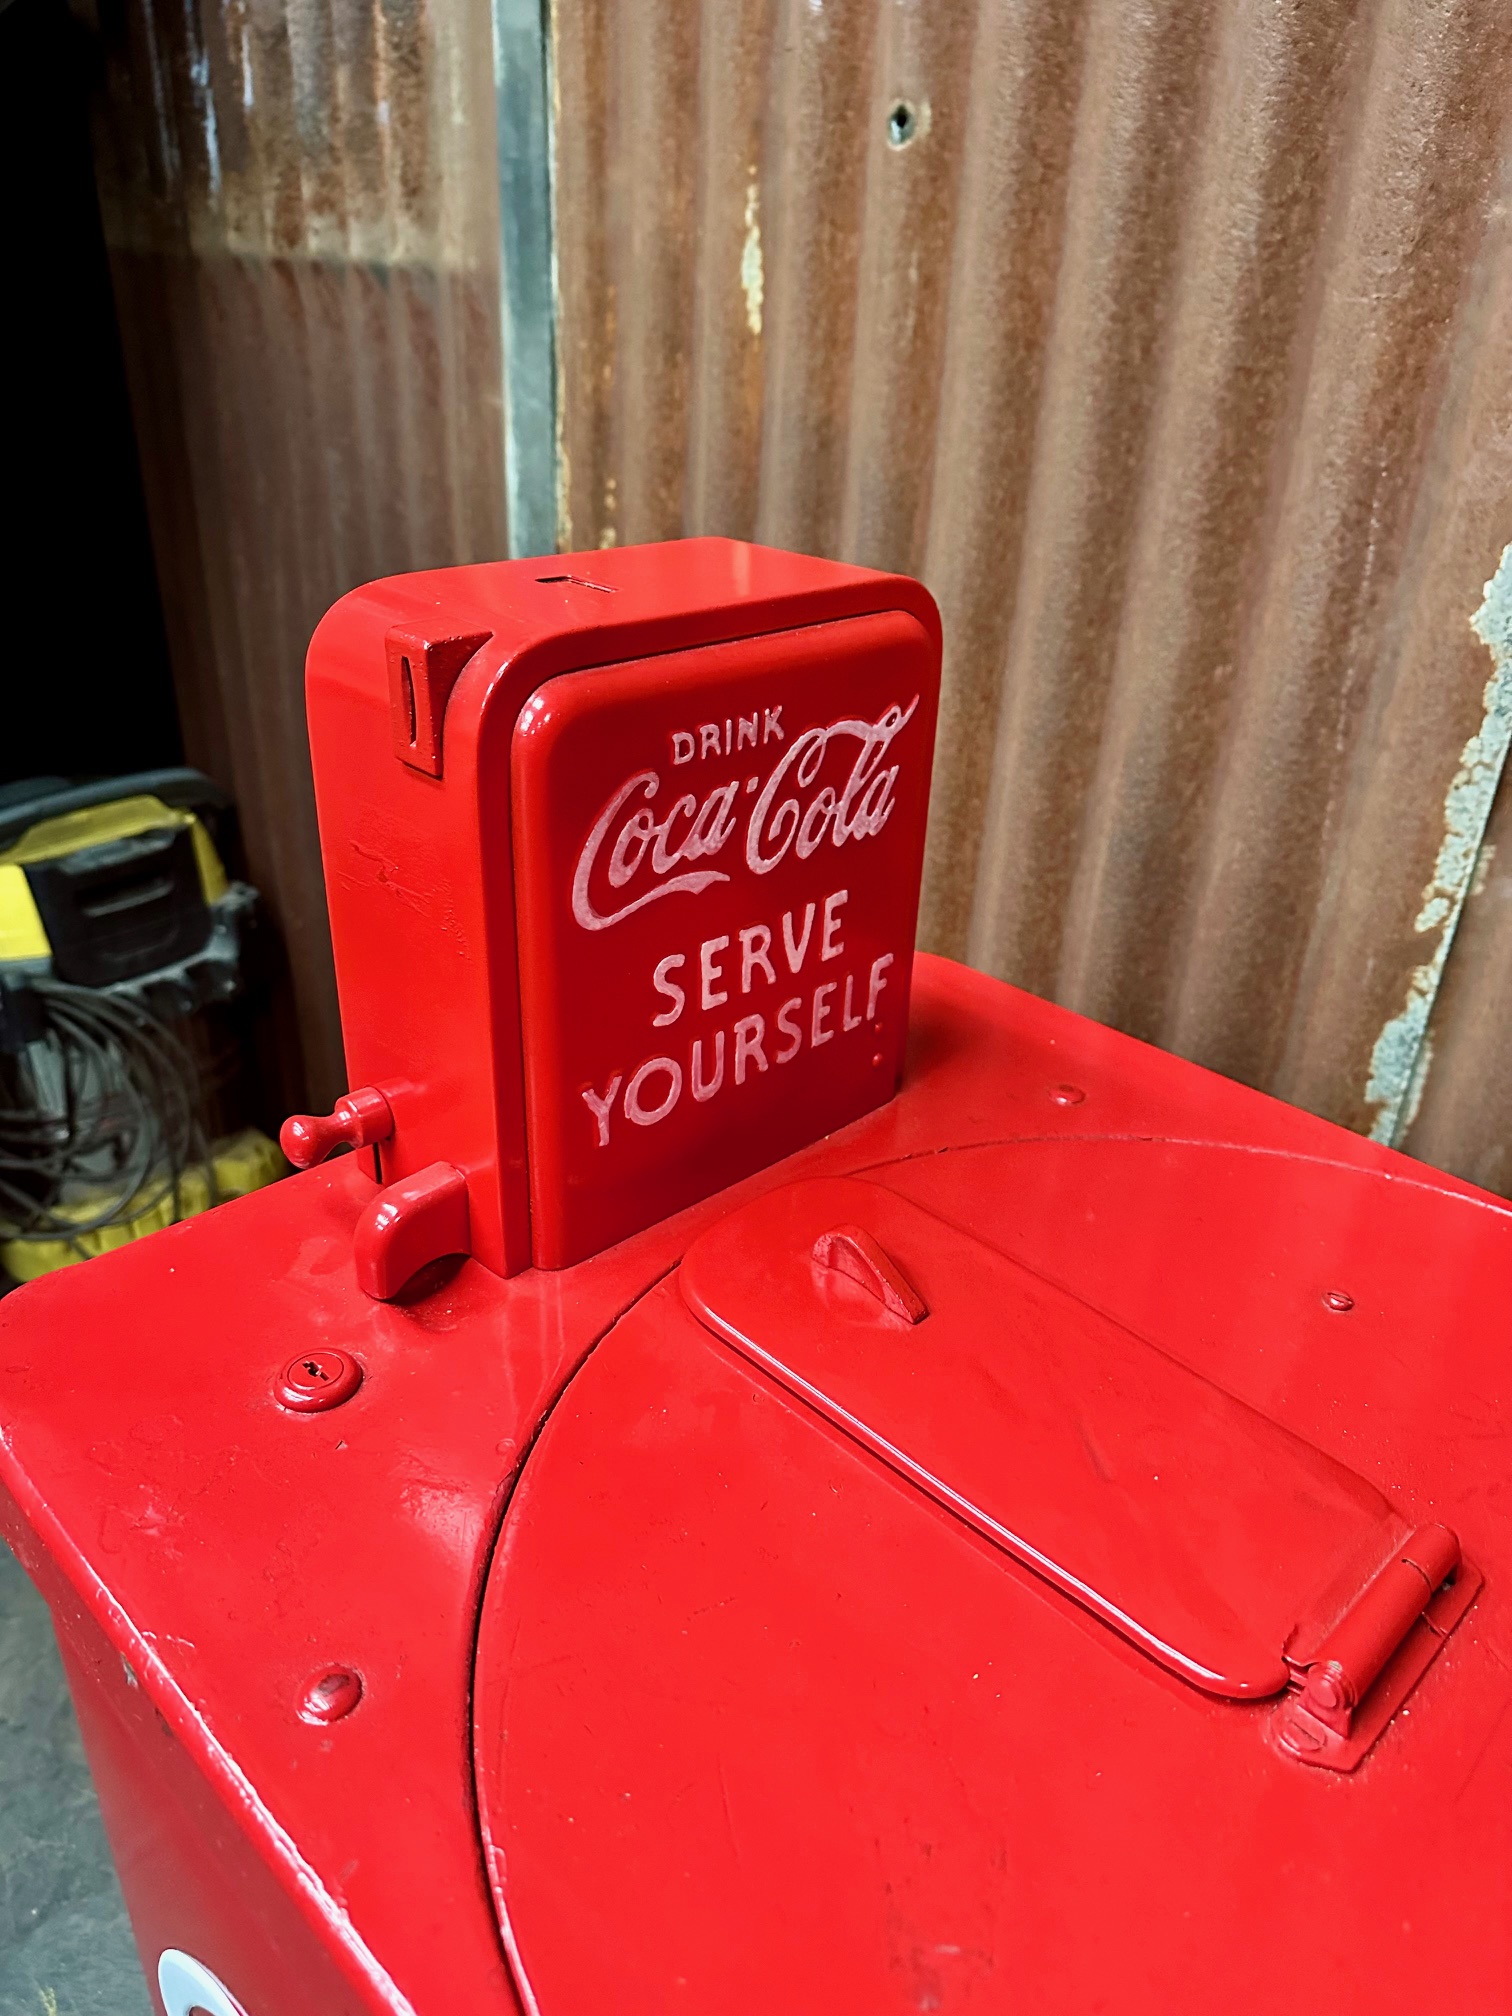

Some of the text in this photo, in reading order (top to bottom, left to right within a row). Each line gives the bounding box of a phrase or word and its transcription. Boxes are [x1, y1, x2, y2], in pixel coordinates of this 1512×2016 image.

[673, 704, 784, 765] DRINK
[652, 889, 848, 1027] SERVE
[582, 953, 895, 1147] YOURSELF
